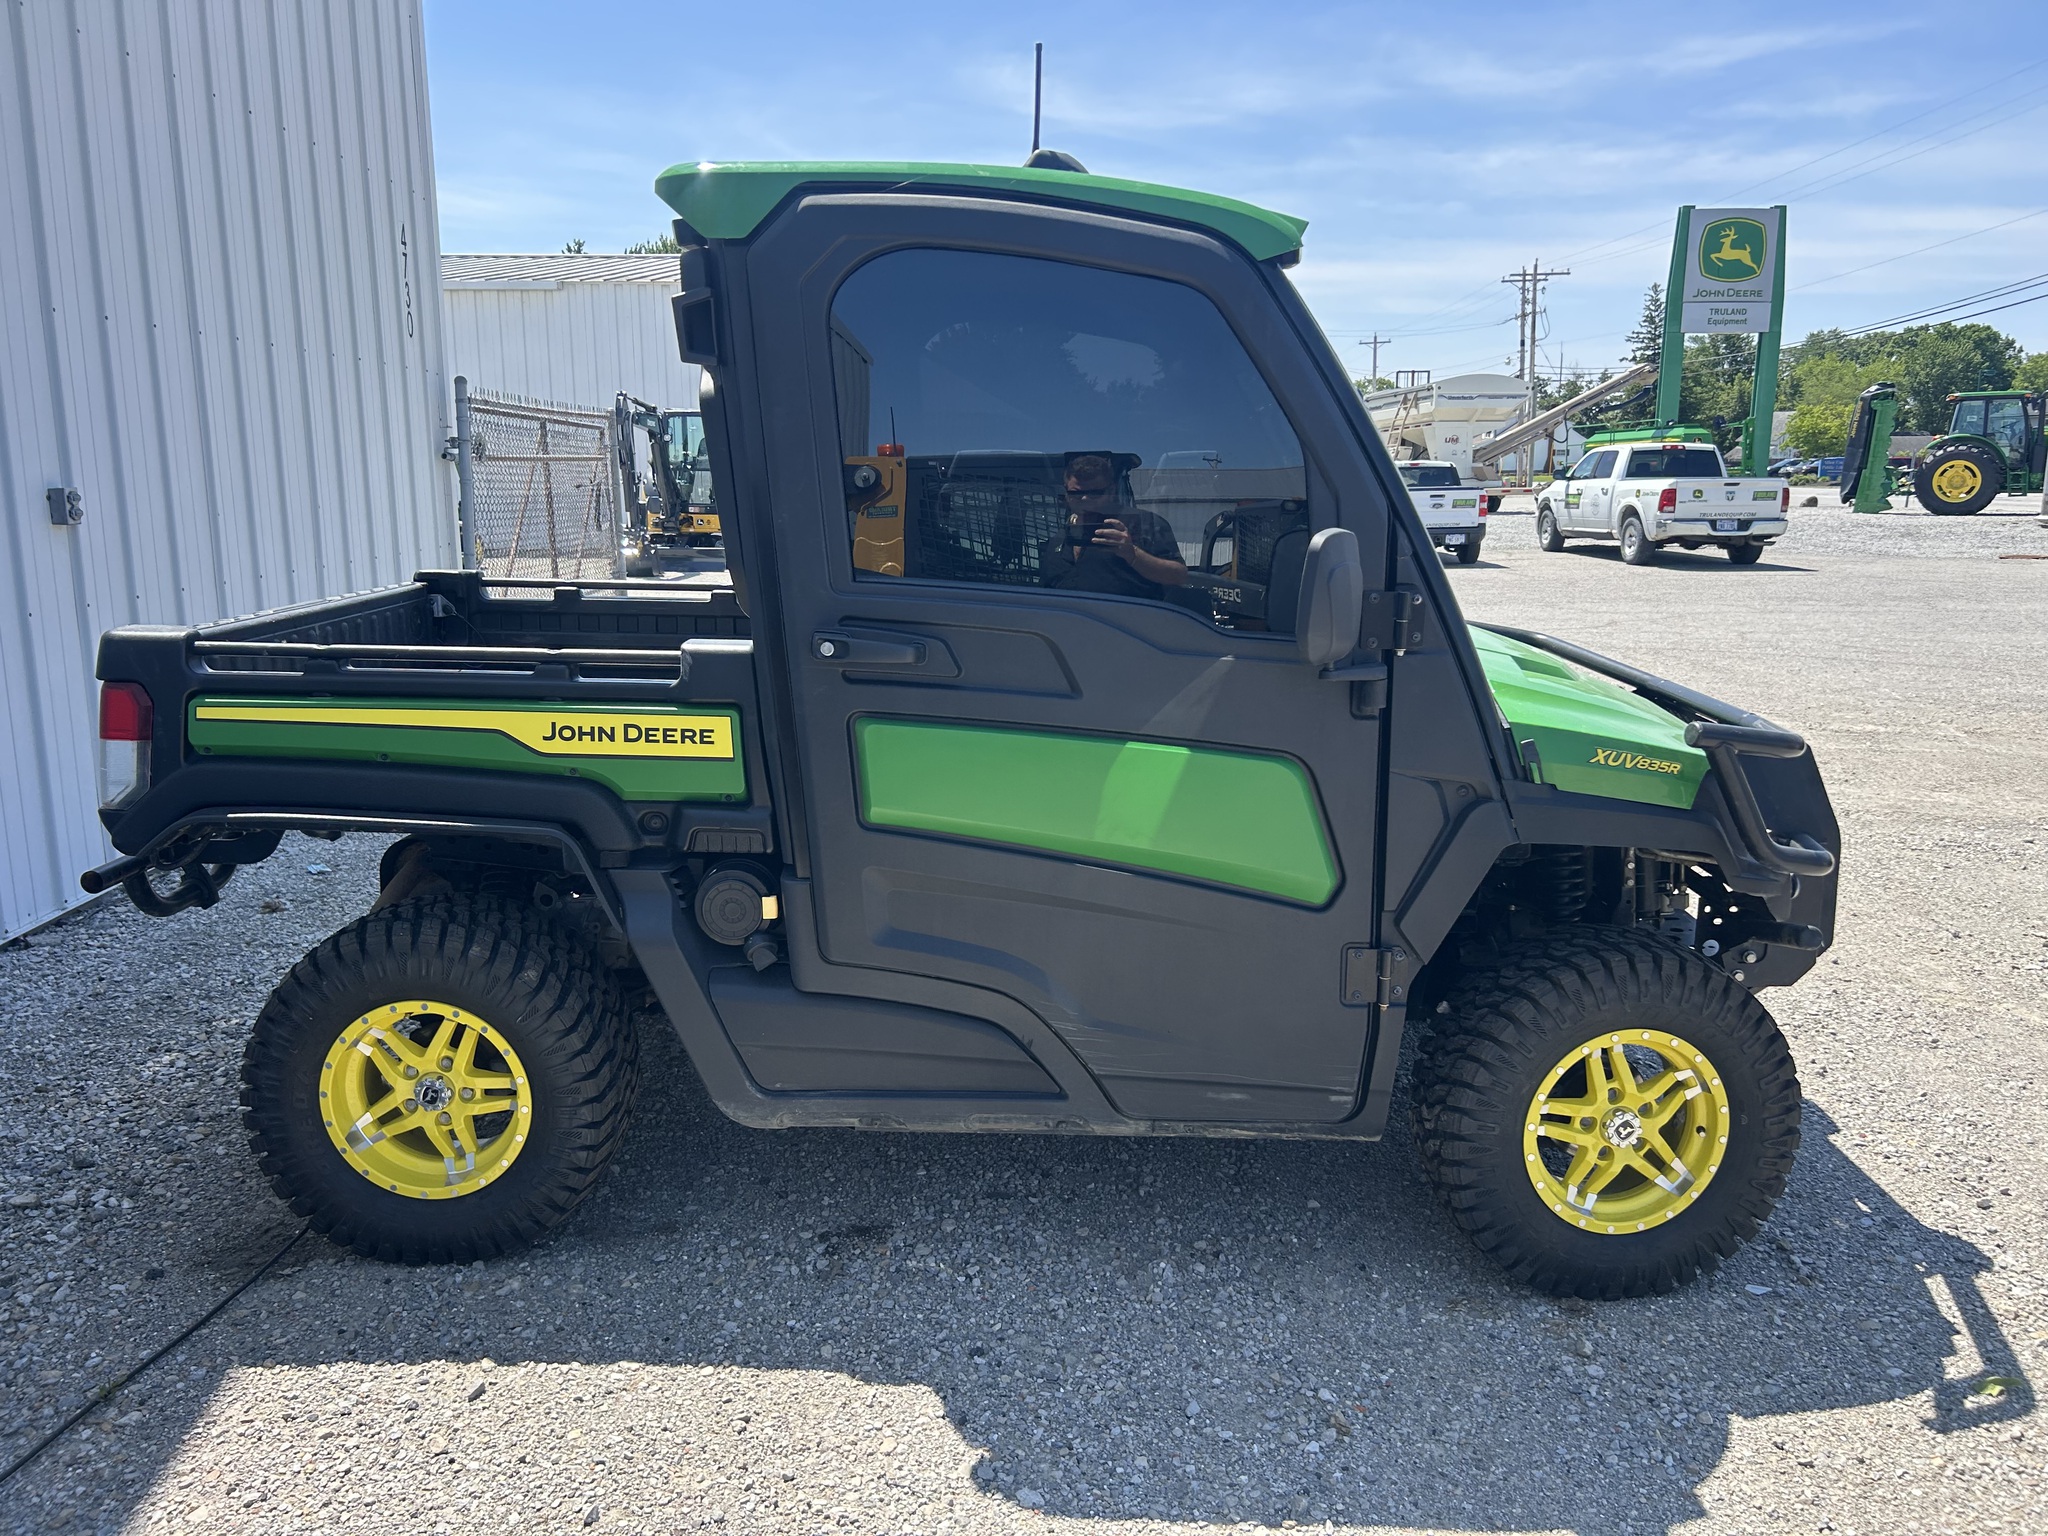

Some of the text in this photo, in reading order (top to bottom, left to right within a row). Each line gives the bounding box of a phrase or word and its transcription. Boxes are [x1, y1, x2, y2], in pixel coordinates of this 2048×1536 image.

[401, 223, 414, 338] 4730
[1692, 288, 1763, 298] JOHN DEERE
[1709, 308, 1747, 316] TRULAND
[1707, 317, 1748, 326] Equipment
[542, 721, 715, 745] JOHN DEERE
[1588, 748, 1681, 775] XUV835R
